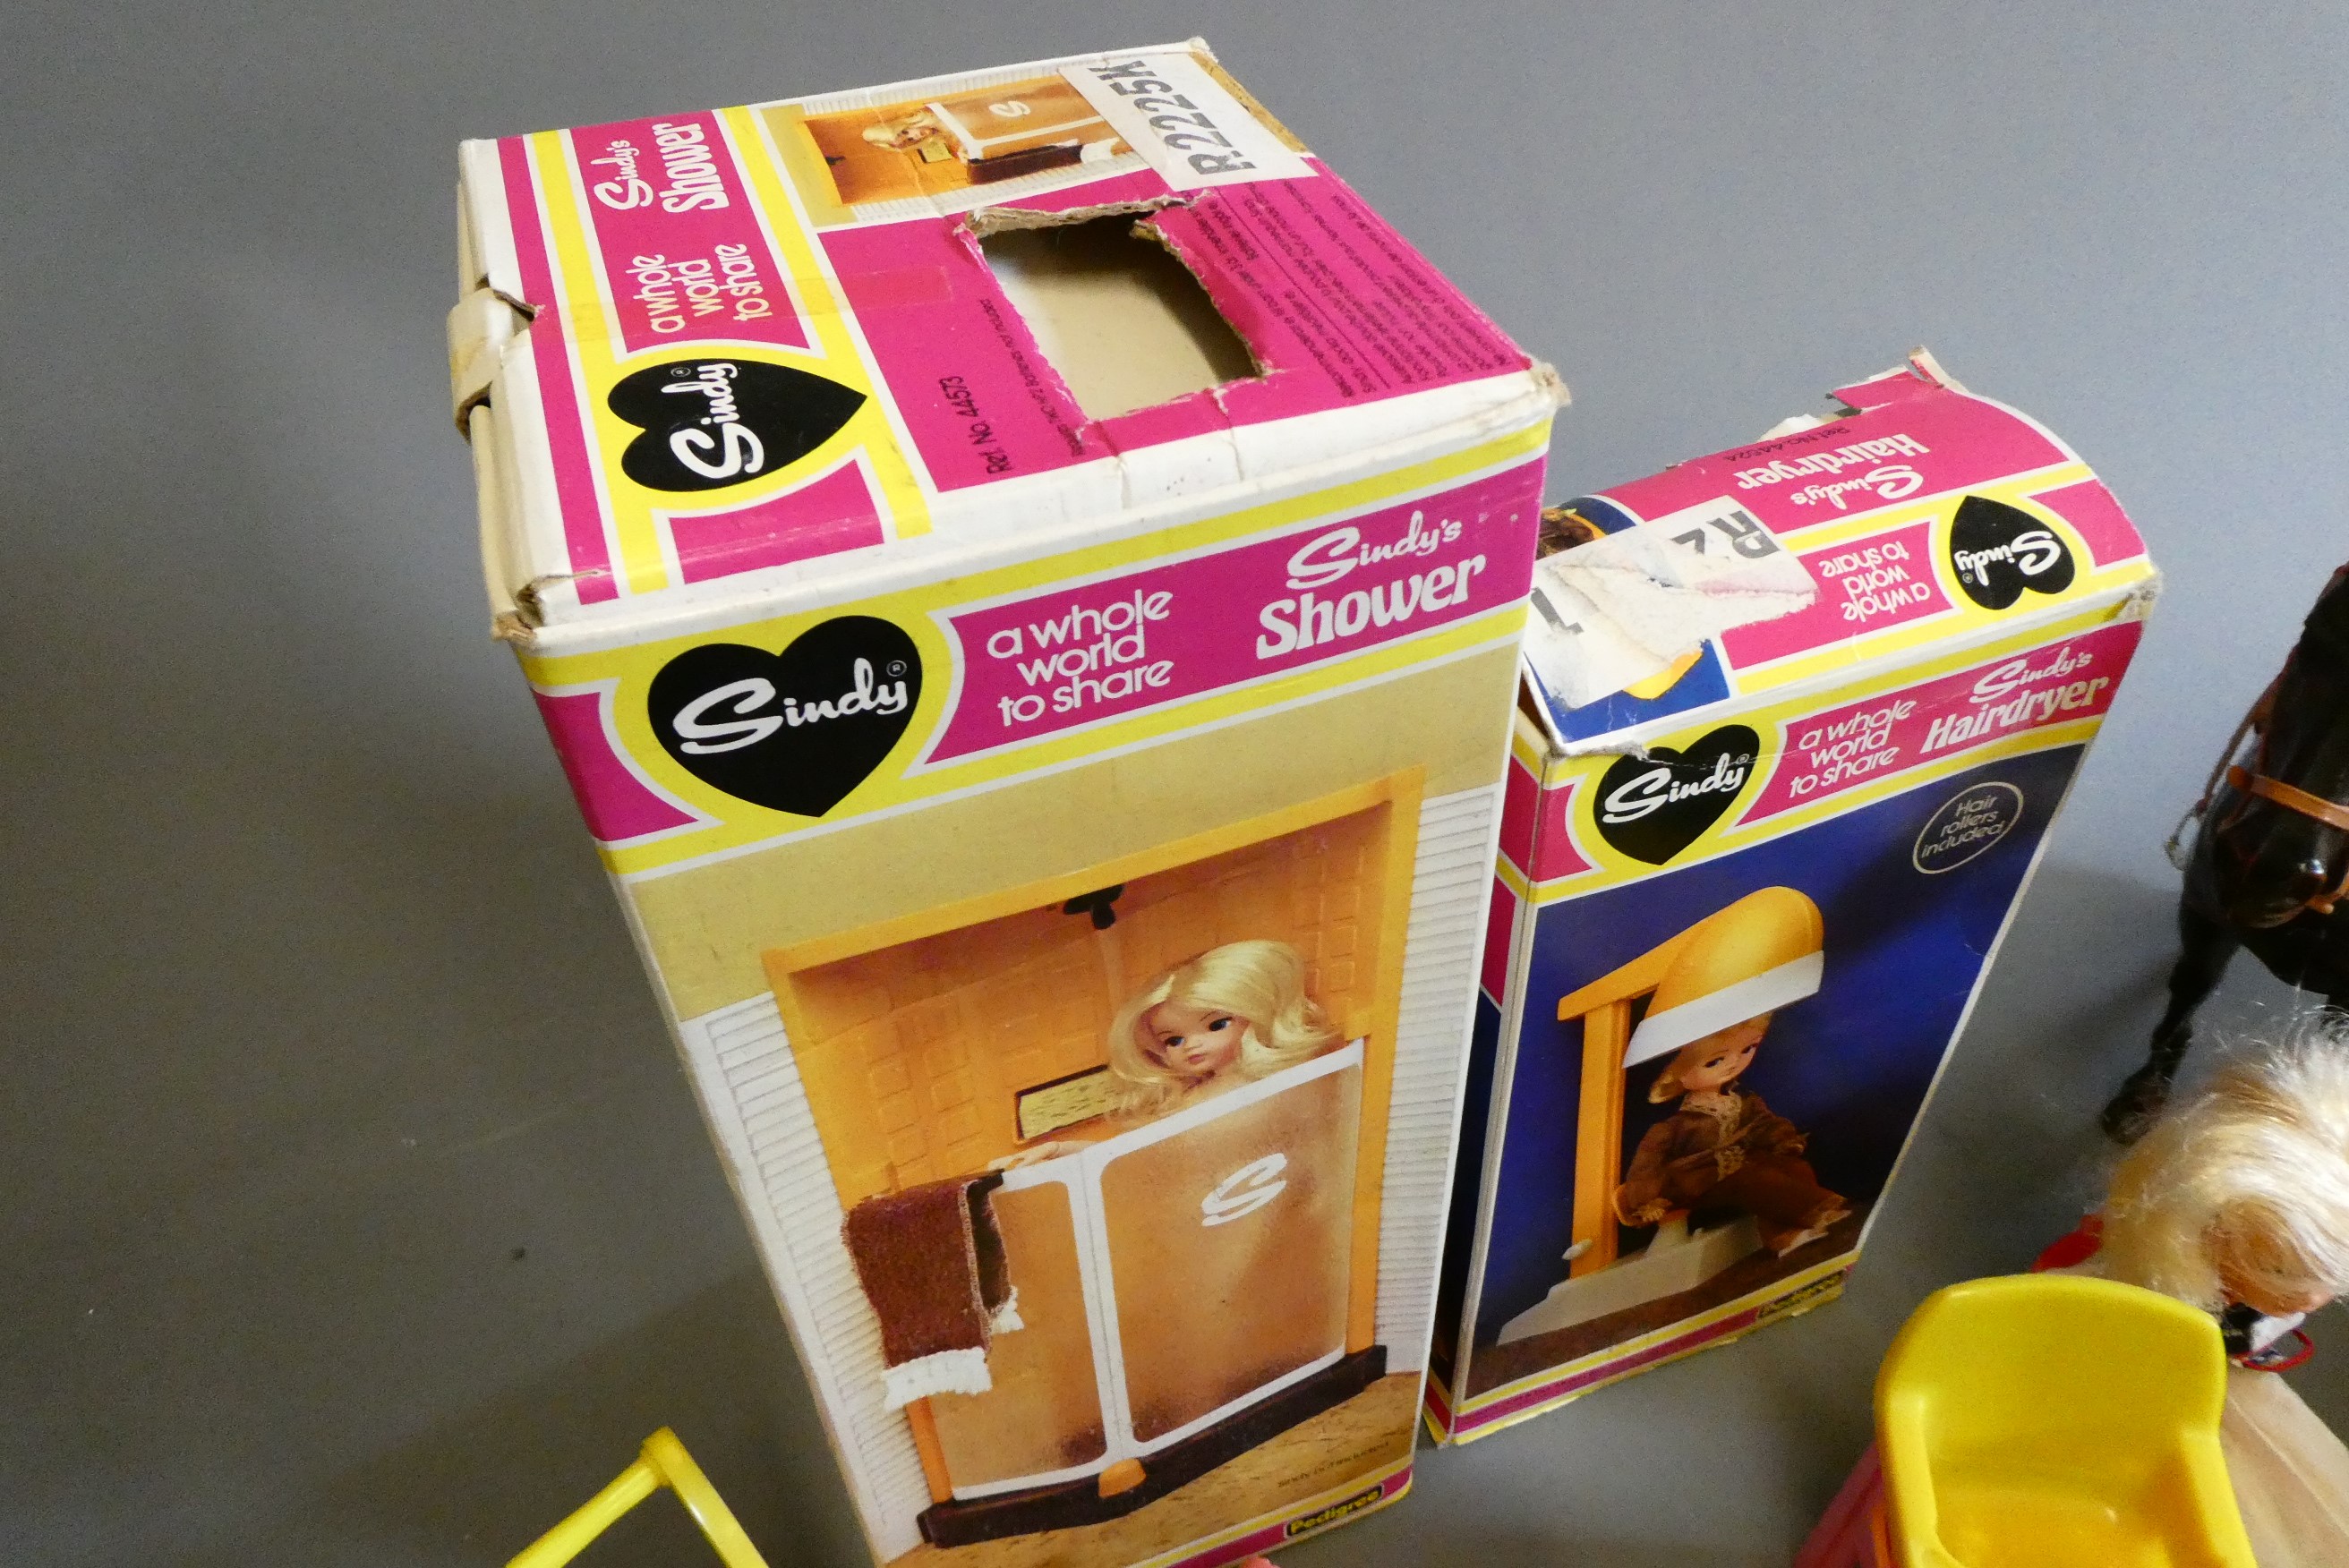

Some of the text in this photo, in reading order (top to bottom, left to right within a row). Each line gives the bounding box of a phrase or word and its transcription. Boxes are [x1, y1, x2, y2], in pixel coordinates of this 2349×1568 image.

[591, 141, 653, 209] Sindy's
[652, 123, 730, 212] Shower
[626, 254, 686, 333] a whole
[667, 259, 724, 317] world
[714, 243, 773, 321] to share
[662, 362, 764, 479] Sindy
[1733, 433, 1930, 489] Hairdryer
[1790, 464, 1924, 510] Sindy's
[1286, 511, 1462, 590] Sindy's
[1819, 541, 1910, 578] to share
[1954, 530, 2061, 586] Sindy
[1257, 555, 1486, 660] Shower
[1841, 565, 1911, 595] world
[1841, 582, 1931, 623] a whole
[987, 589, 1174, 660] a whole
[1016, 625, 1145, 686] world
[1969, 646, 2093, 703] Sindy's
[672, 657, 909, 755] Sindy
[997, 660, 1174, 727] to share
[1919, 677, 2109, 754] Hairdryer
[1798, 699, 1918, 750] a whole
[1810, 722, 1892, 769] world
[1603, 759, 1746, 823] Sindy
[1789, 746, 1900, 798] to share
[1939, 811, 1999, 838] rollers
[1955, 795, 1999, 816] Hair
[1921, 821, 2005, 858] included
